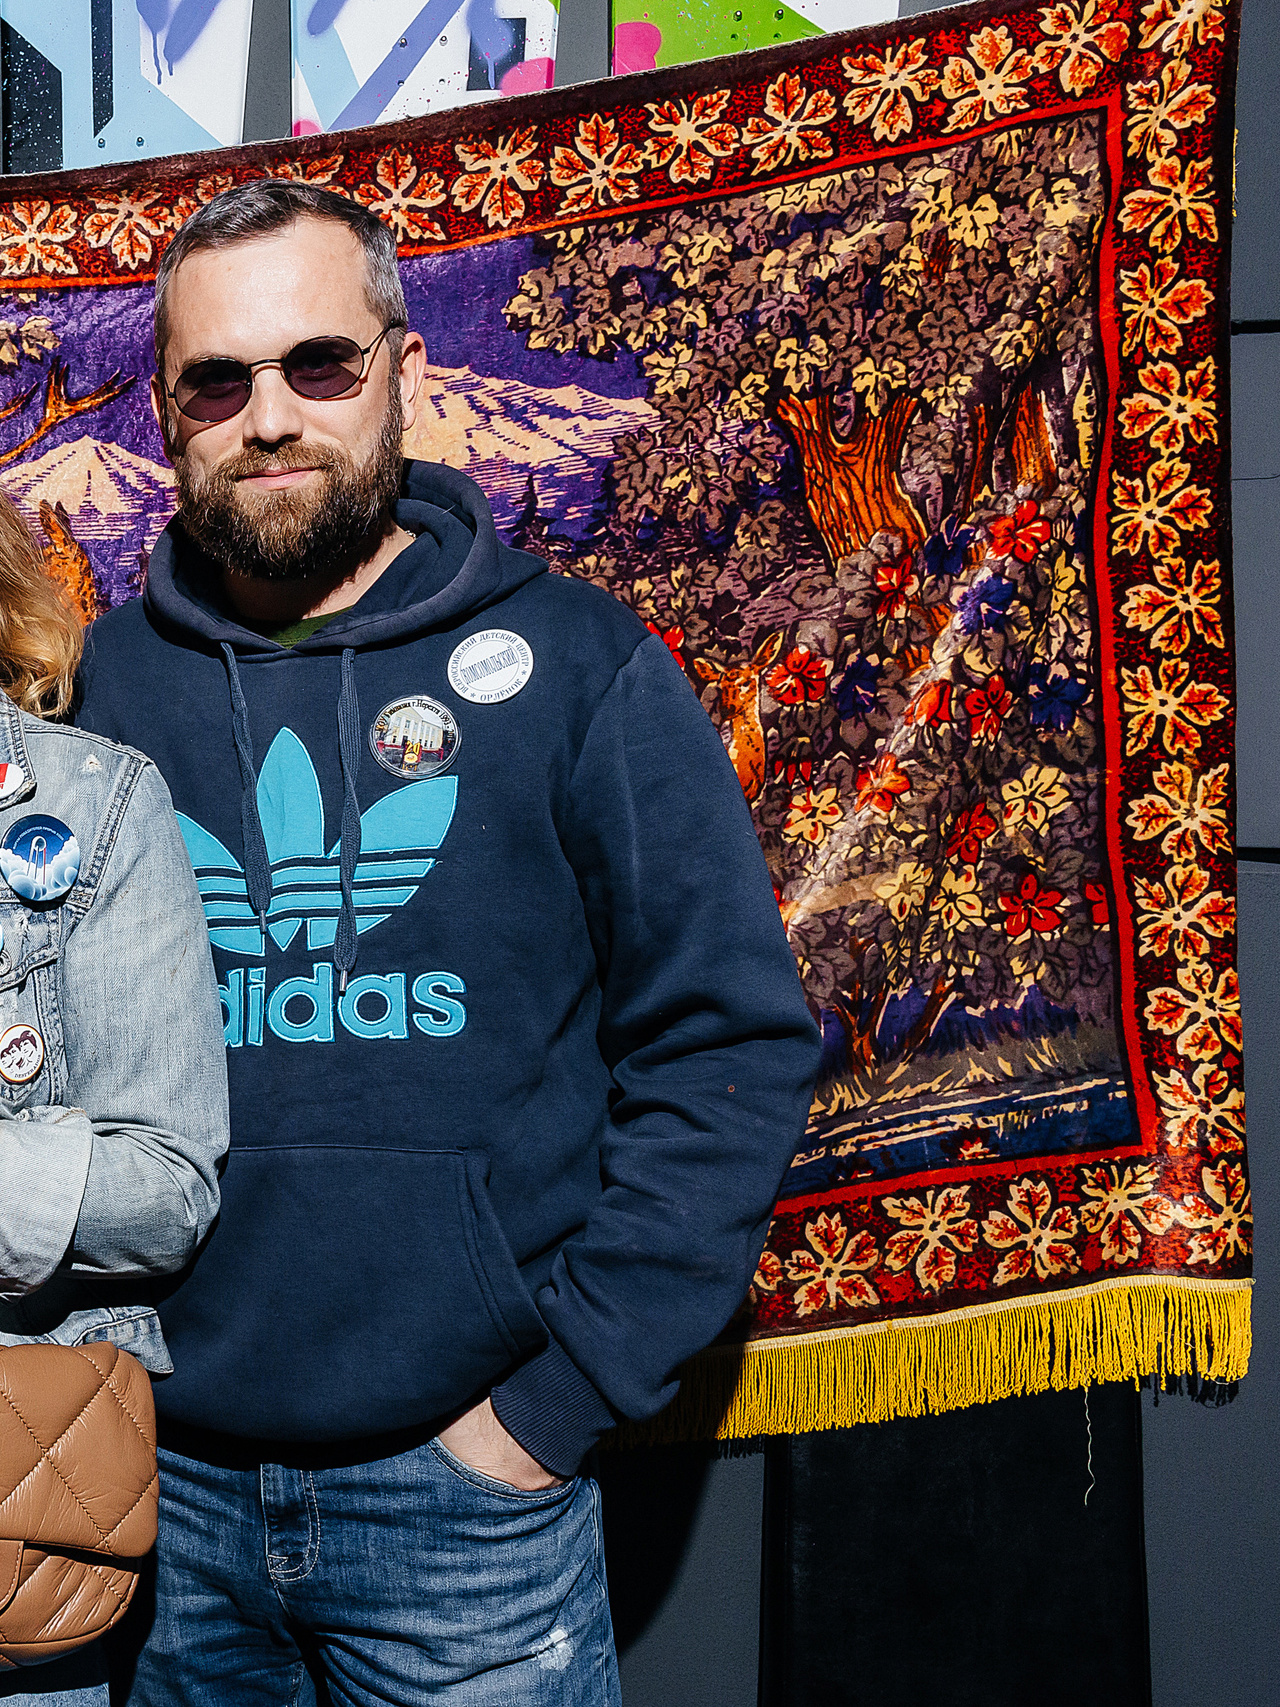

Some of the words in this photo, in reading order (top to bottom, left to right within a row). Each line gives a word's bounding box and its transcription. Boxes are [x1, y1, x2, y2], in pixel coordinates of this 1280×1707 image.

[451, 637, 477, 694] ВСЕРОССИЙСКИЙ
[479, 632, 518, 645] ДЕТСКИЙ
[515, 642, 529, 667] ЦЕНТР
[460, 645, 518, 684] КОМСОМОЛЬСКИЙ
[405, 740, 421, 756] 20
[219, 962, 469, 1048] idas
[14, 1054, 41, 1079] DESPERADOS
